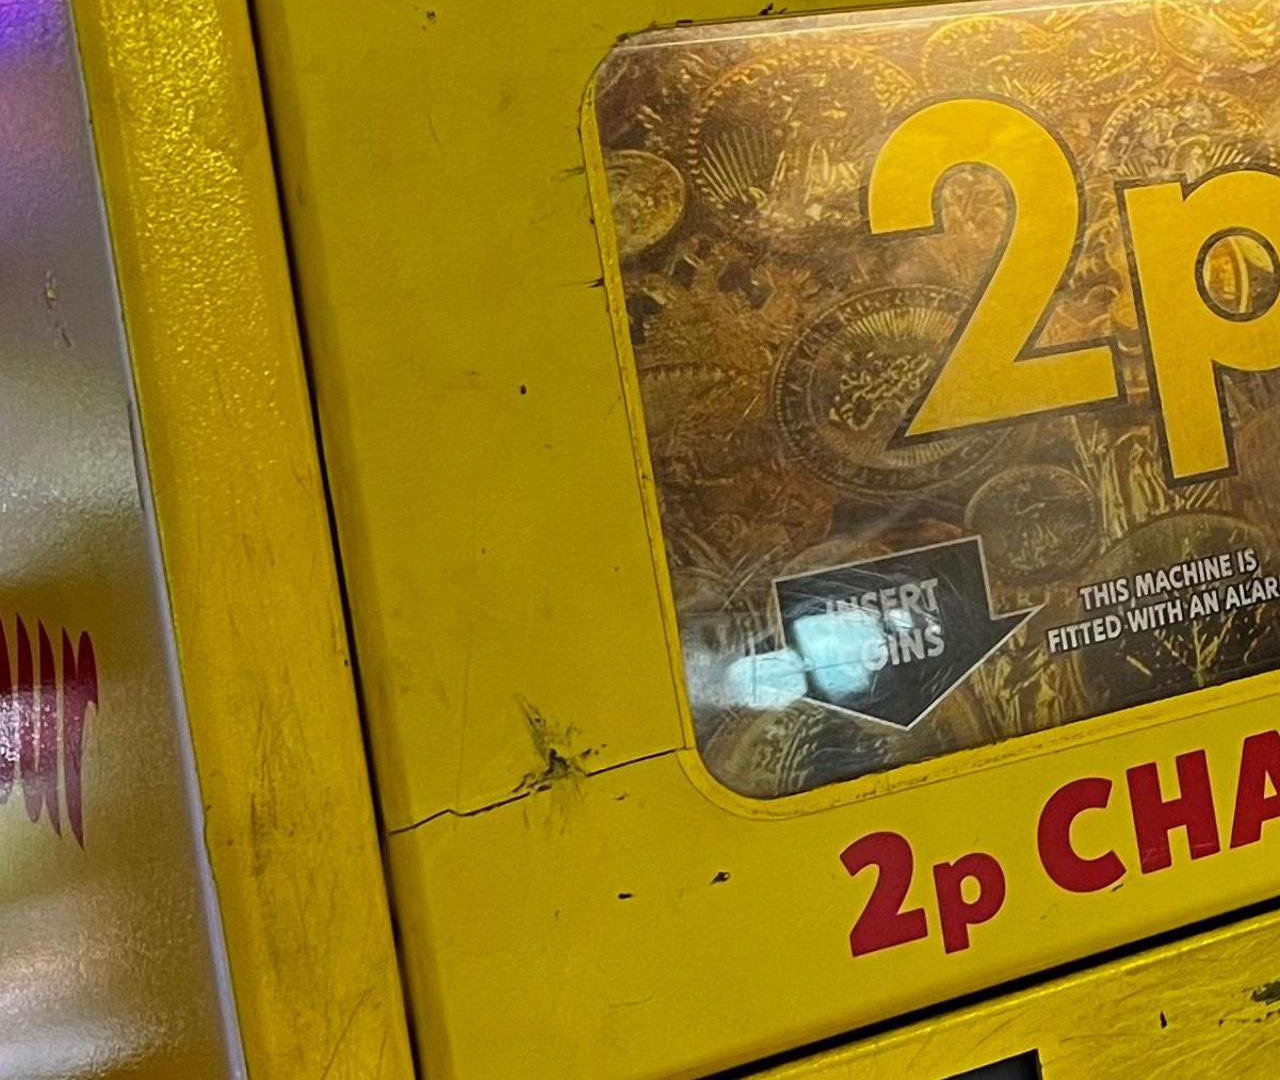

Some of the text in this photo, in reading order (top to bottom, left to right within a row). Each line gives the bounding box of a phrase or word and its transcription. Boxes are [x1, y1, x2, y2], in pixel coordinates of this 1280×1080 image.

[1080, 547, 1258, 610] THIS MACHINE IS
[1047, 615, 1122, 653] FITTED
[1127, 599, 1183, 633] WITH
[1190, 590, 1219, 619] AN
[839, 829, 1006, 957] 2p
